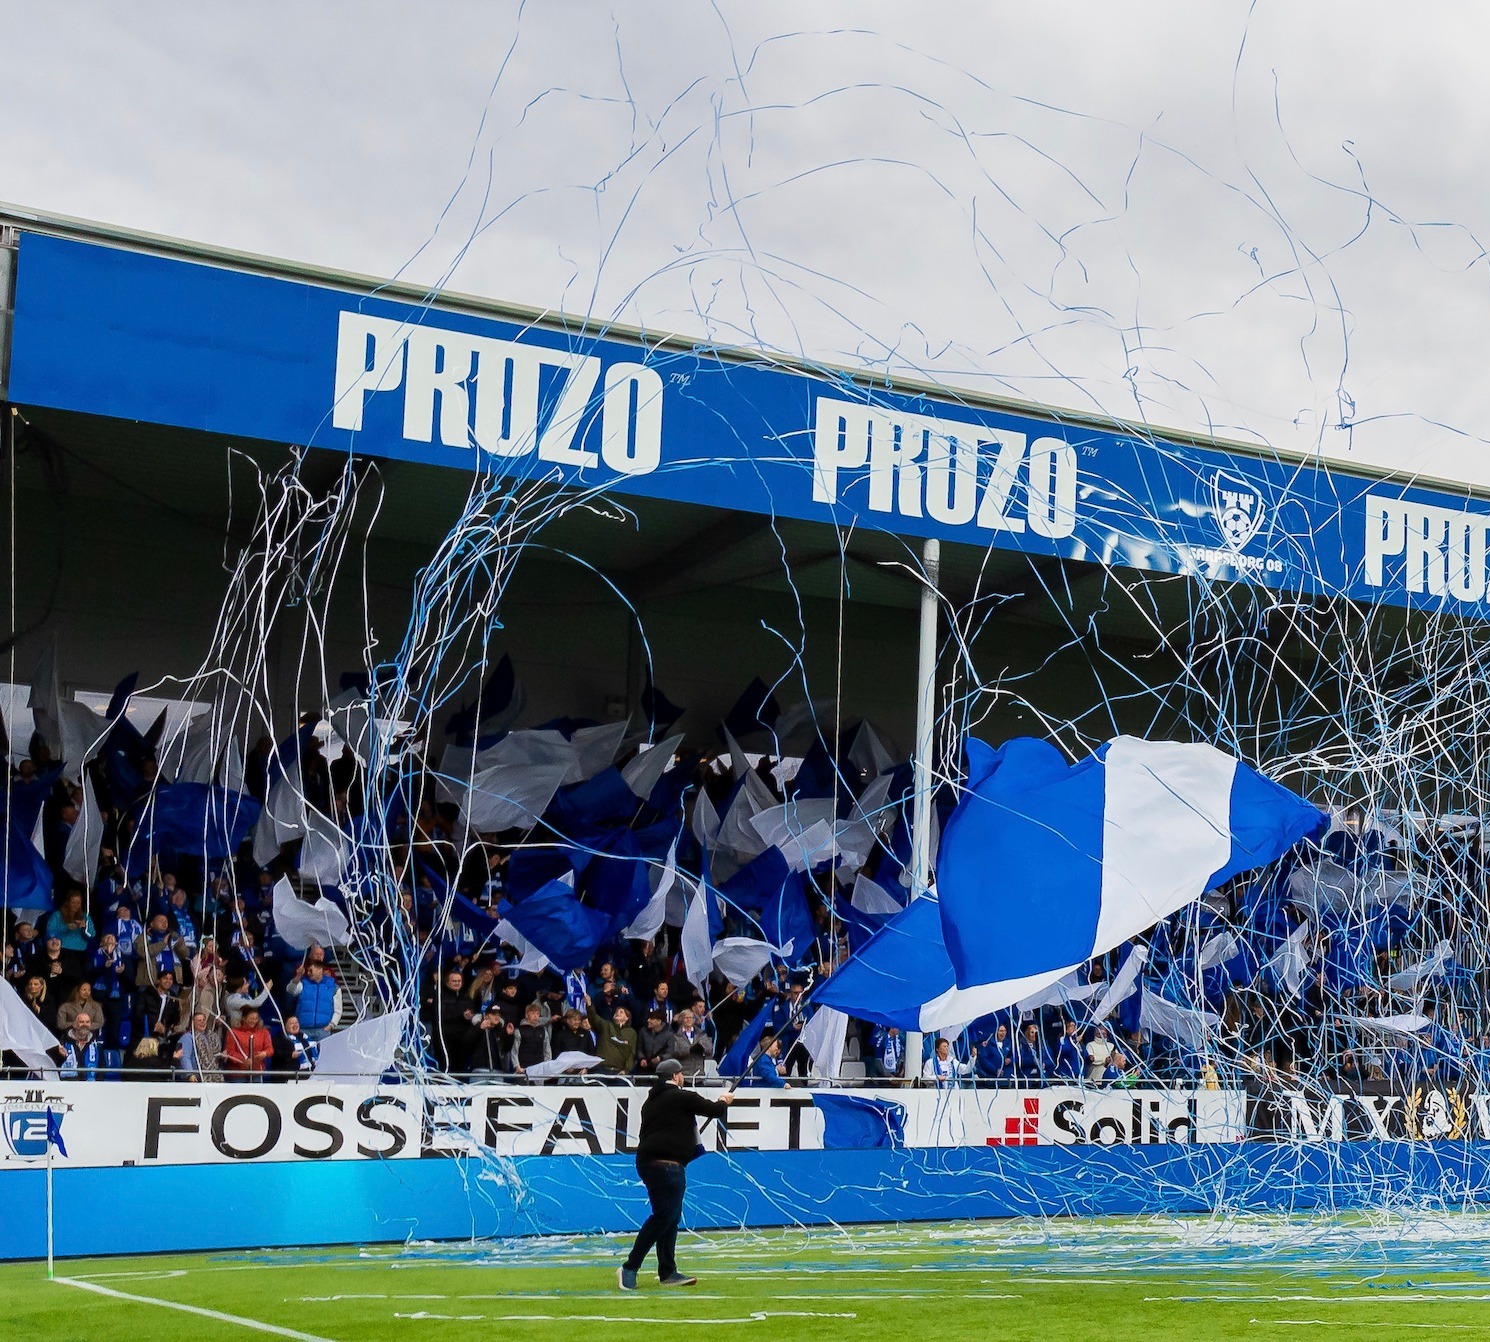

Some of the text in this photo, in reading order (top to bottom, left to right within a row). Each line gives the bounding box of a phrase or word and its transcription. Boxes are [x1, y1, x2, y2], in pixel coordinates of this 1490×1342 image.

[333, 311, 664, 475] PRUZO
[812, 396, 1078, 539] PRUZO
[144, 1093, 816, 1159] FOSSEFALET
[1053, 1098, 1198, 1145] Solid
